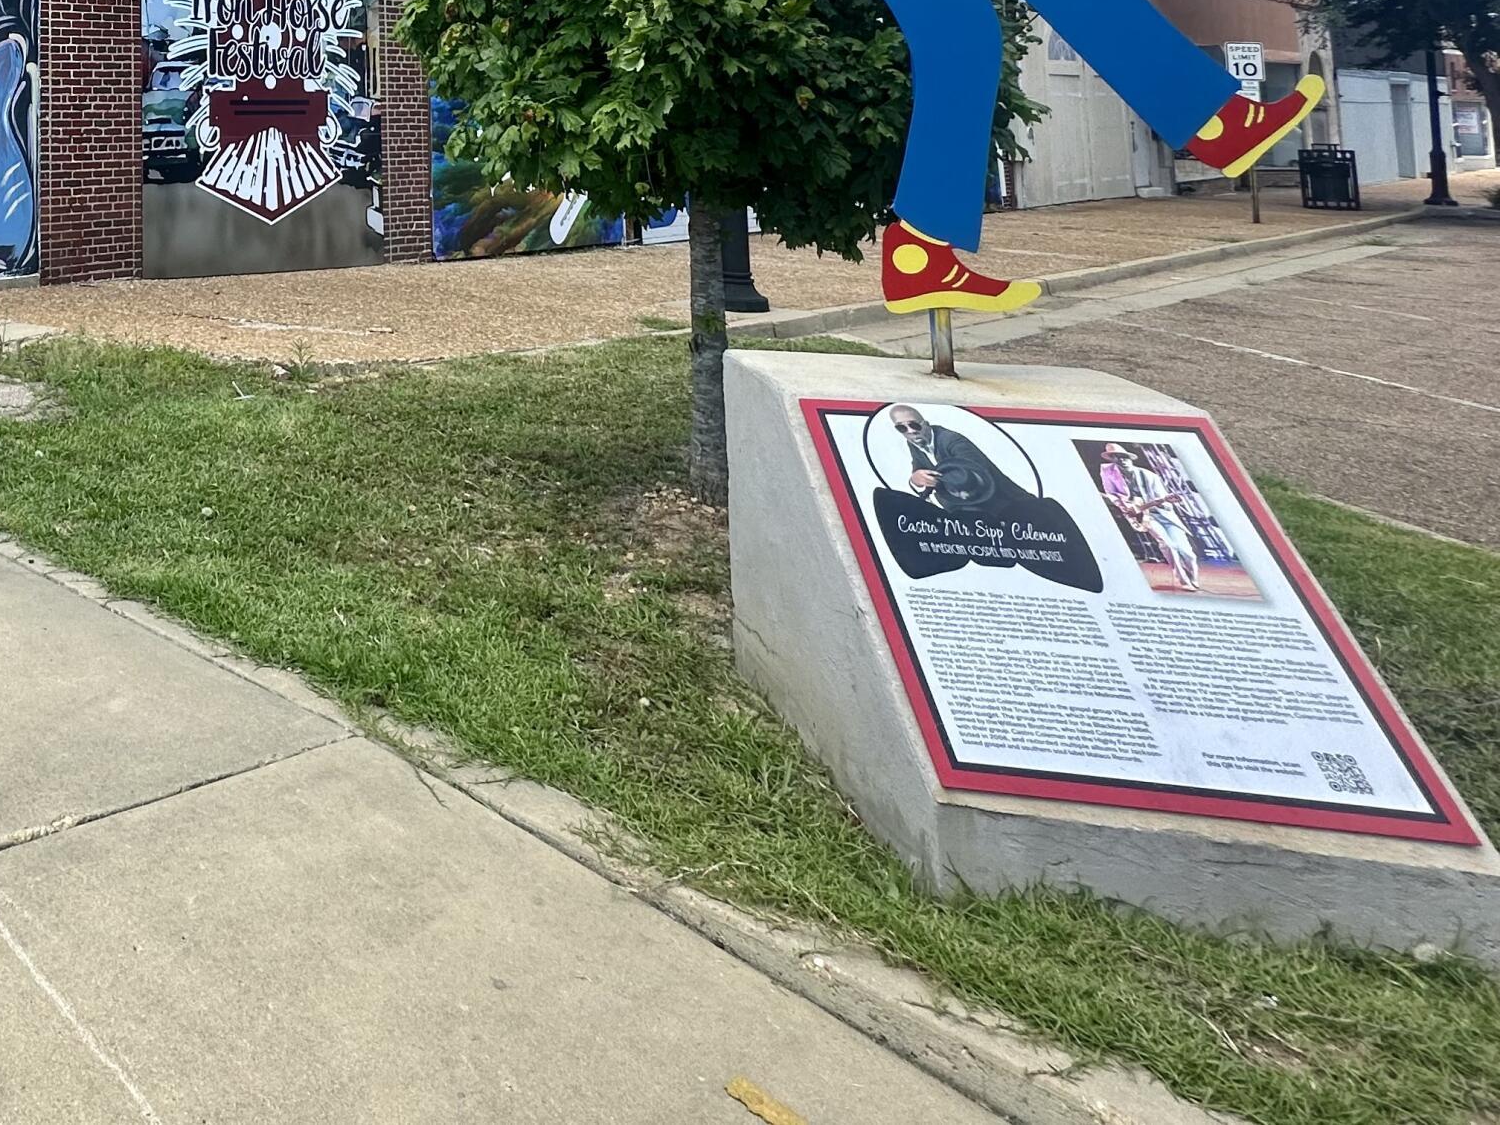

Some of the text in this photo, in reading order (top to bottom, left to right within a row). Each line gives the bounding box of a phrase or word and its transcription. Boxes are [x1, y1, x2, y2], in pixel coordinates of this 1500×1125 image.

[208, 26, 326, 82] Festival
[1233, 62, 1258, 76] 10
[897, 514, 938, 534] Castro
[1011, 522, 1067, 543] Coleman
[968, 545, 1000, 558] GOSPEL
